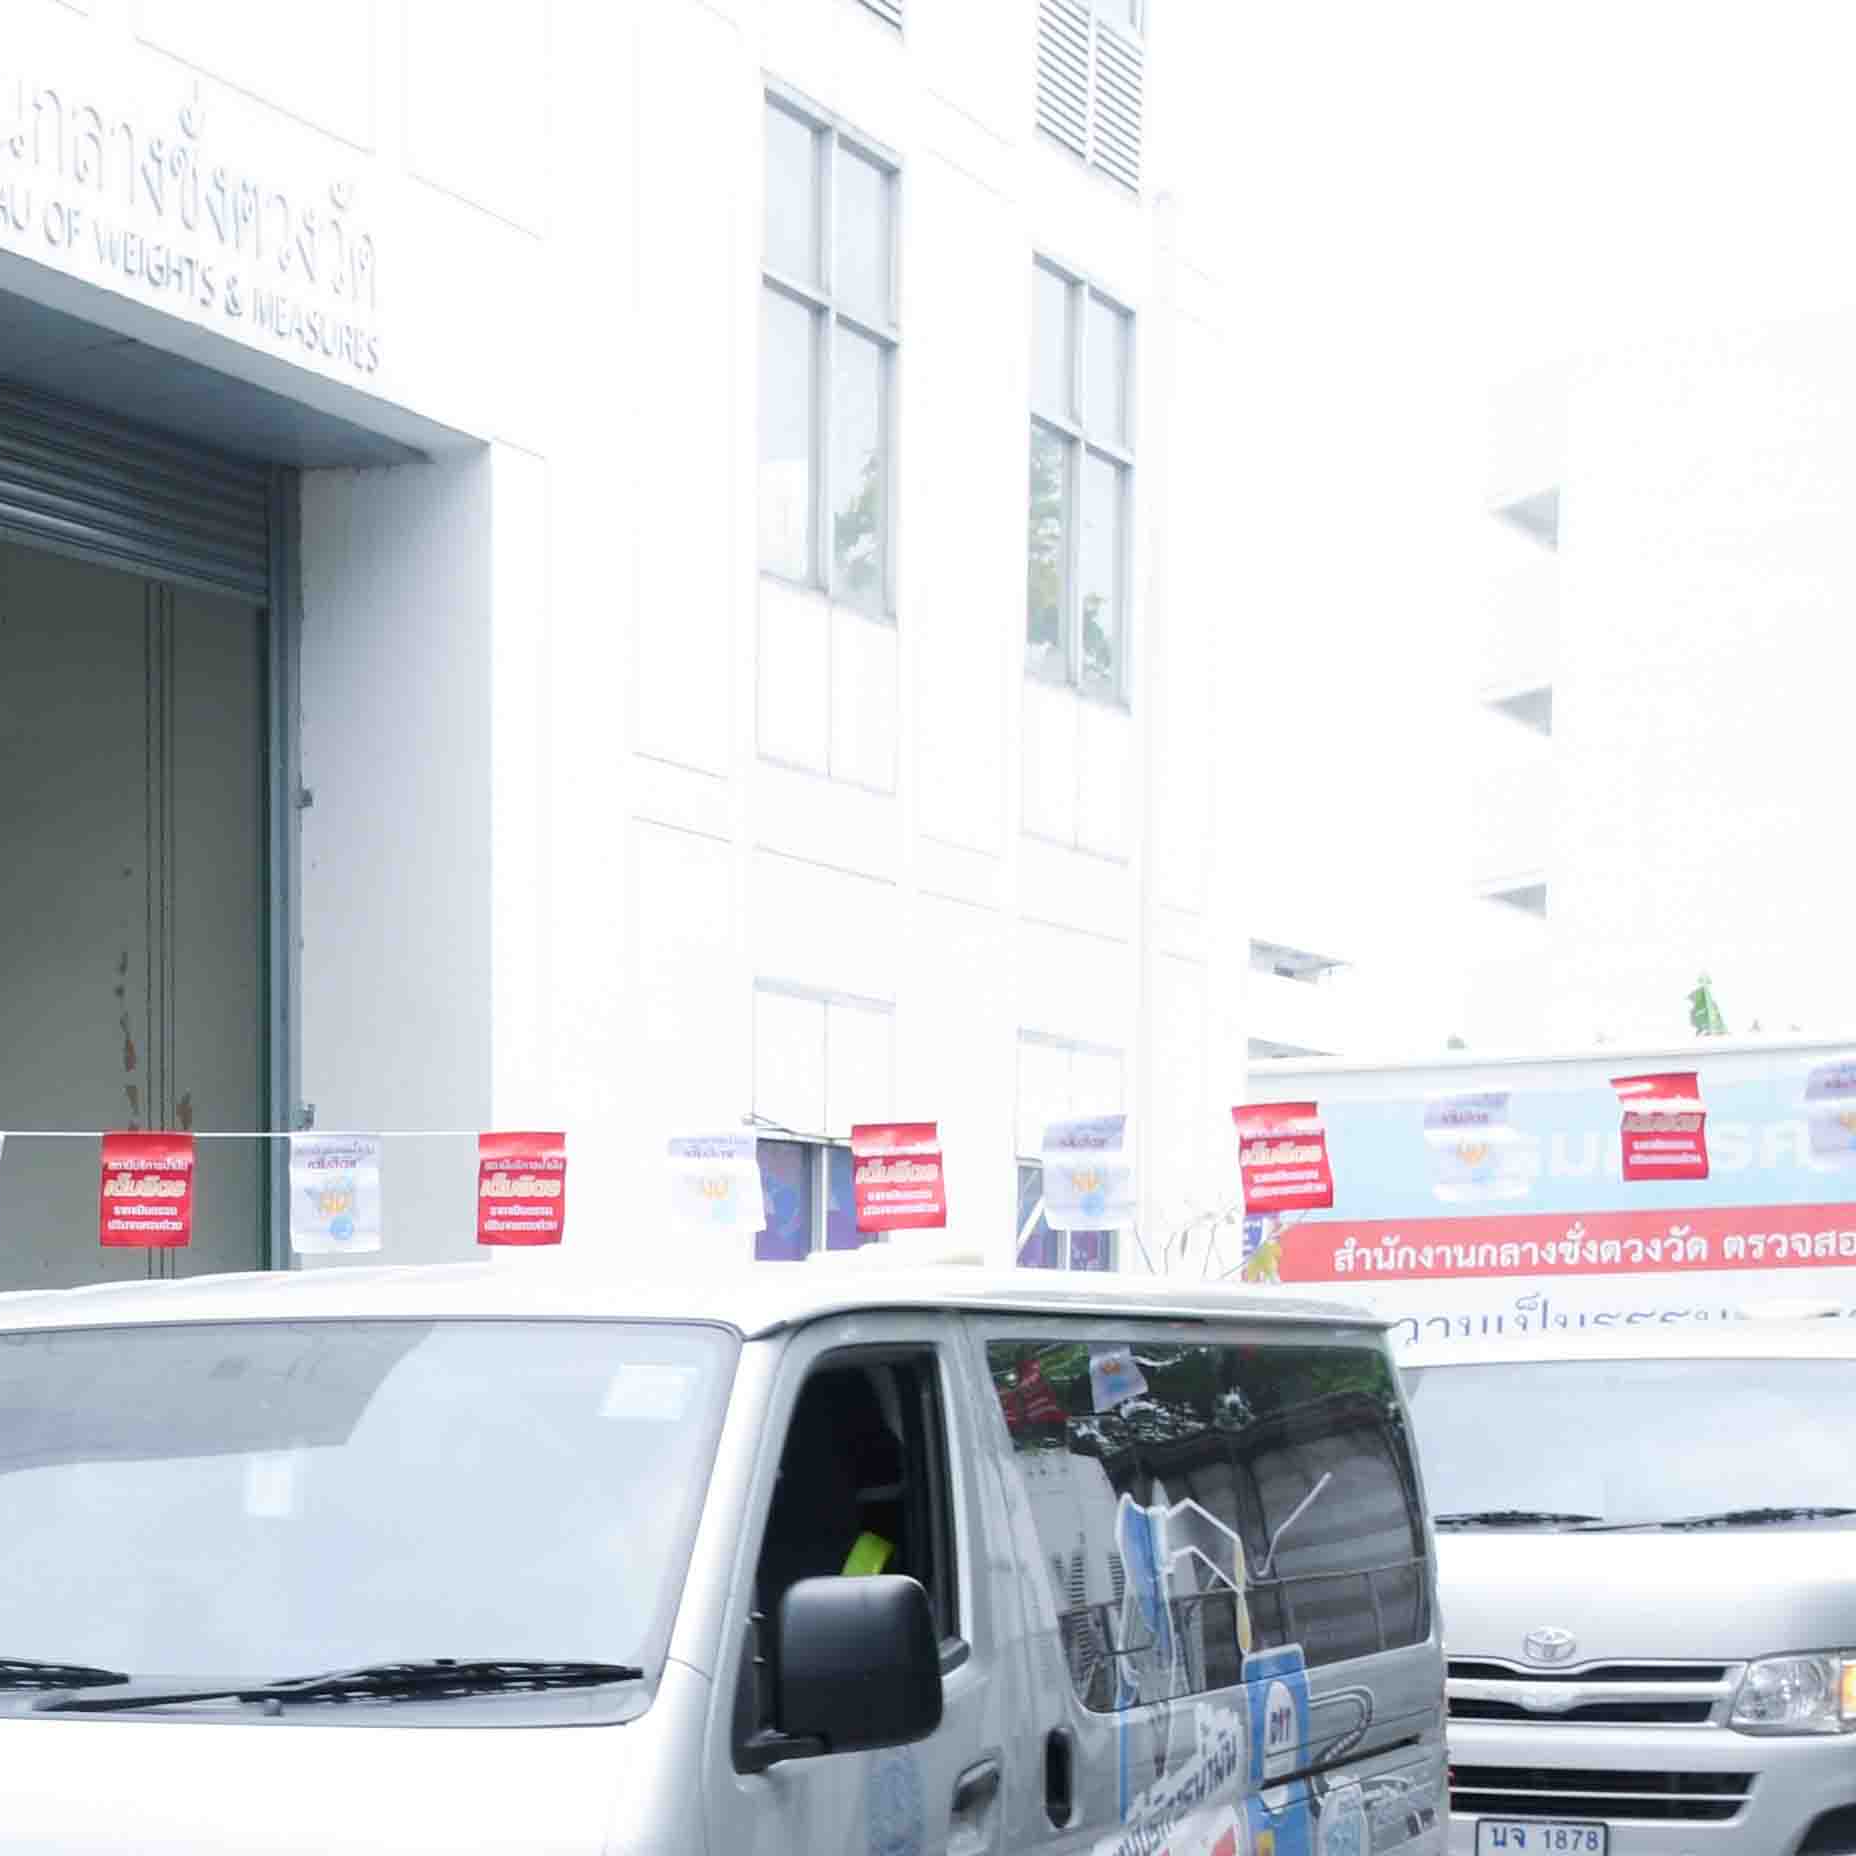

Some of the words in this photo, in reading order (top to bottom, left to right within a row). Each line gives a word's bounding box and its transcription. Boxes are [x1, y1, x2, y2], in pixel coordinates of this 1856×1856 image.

[42, 200, 81, 250] OF
[95, 218, 218, 308] WEIGHTS
[222, 273, 244, 318] &
[252, 290, 381, 375] MEASURES
